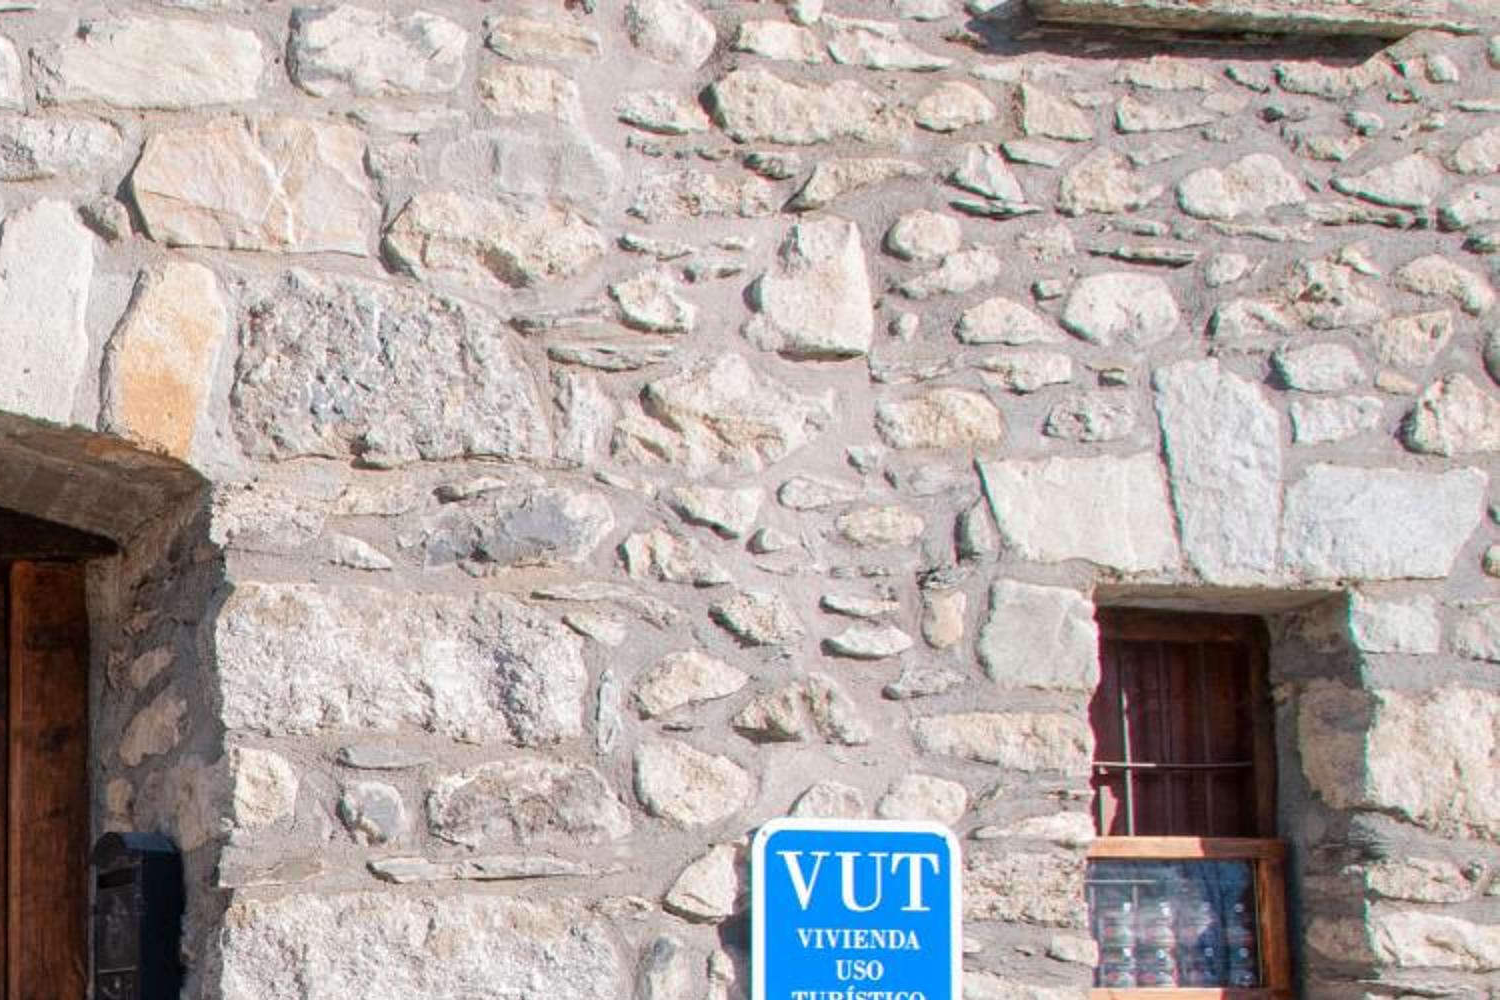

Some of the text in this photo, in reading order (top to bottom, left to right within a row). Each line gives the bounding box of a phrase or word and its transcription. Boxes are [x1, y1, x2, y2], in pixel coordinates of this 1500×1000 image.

[775, 850, 941, 913] VUT
[797, 928, 920, 950] VIVIENDA
[835, 959, 885, 981] USO
